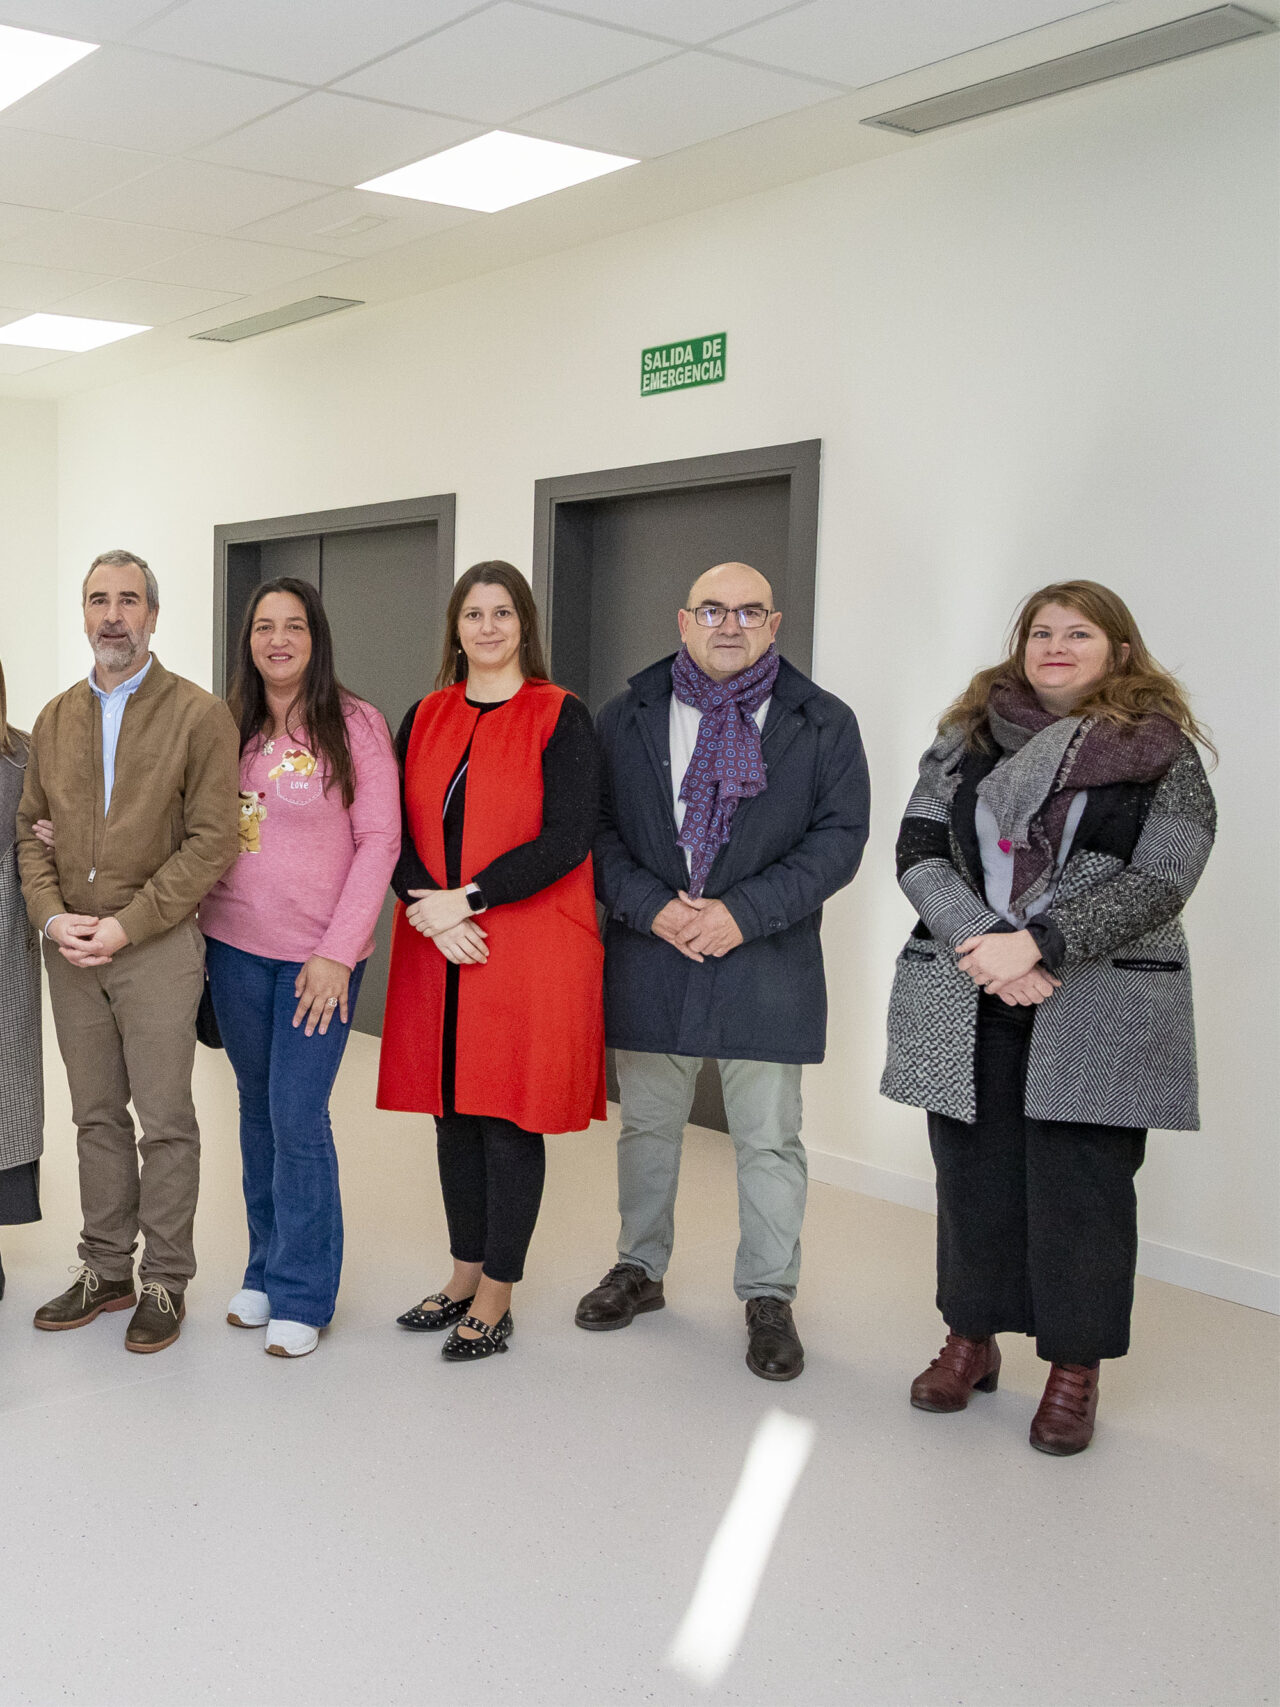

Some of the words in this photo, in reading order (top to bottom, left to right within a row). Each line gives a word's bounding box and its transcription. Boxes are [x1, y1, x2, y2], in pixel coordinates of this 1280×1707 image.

[644, 344, 694, 371] SALIDA
[702, 338, 722, 360] DE
[642, 359, 723, 392] EMERGENCIA
